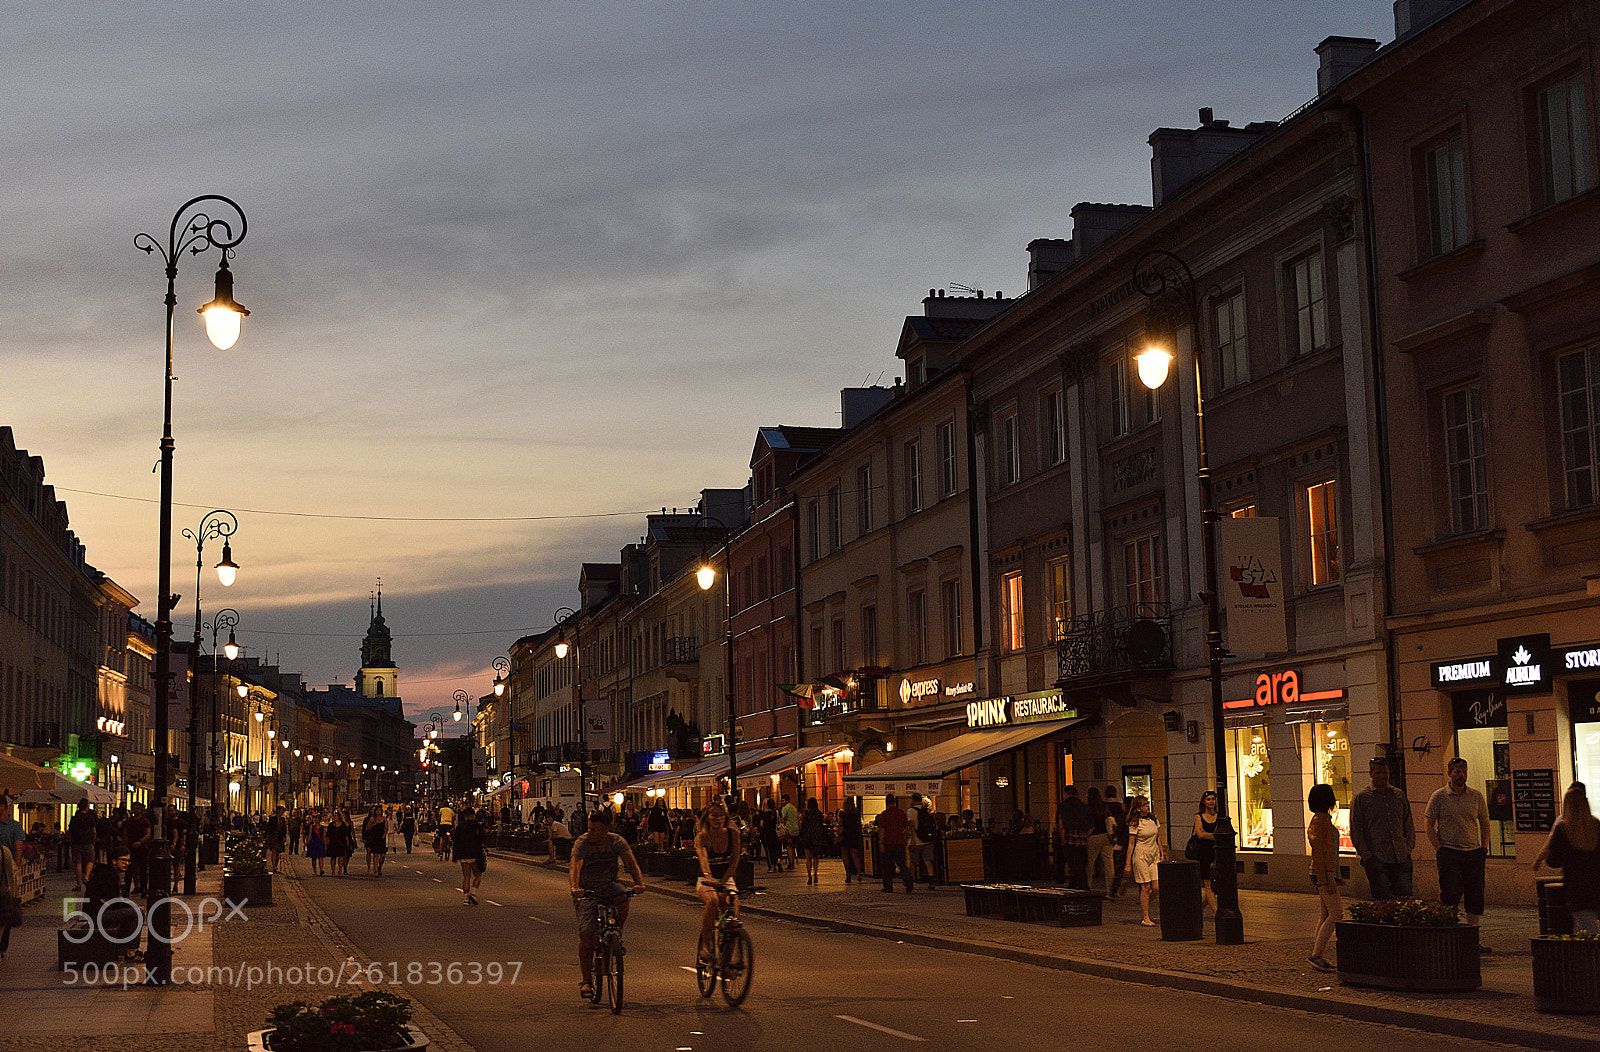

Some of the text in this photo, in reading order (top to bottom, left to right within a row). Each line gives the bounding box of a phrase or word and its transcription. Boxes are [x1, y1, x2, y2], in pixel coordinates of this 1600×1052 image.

[1438, 660, 1491, 682] PREMIUM
[912, 678, 940, 701] express
[1255, 669, 1300, 707] ara
[966, 698, 1008, 728] SPHINX
[1250, 742, 1266, 756] ara
[1329, 738, 1348, 752] ara
